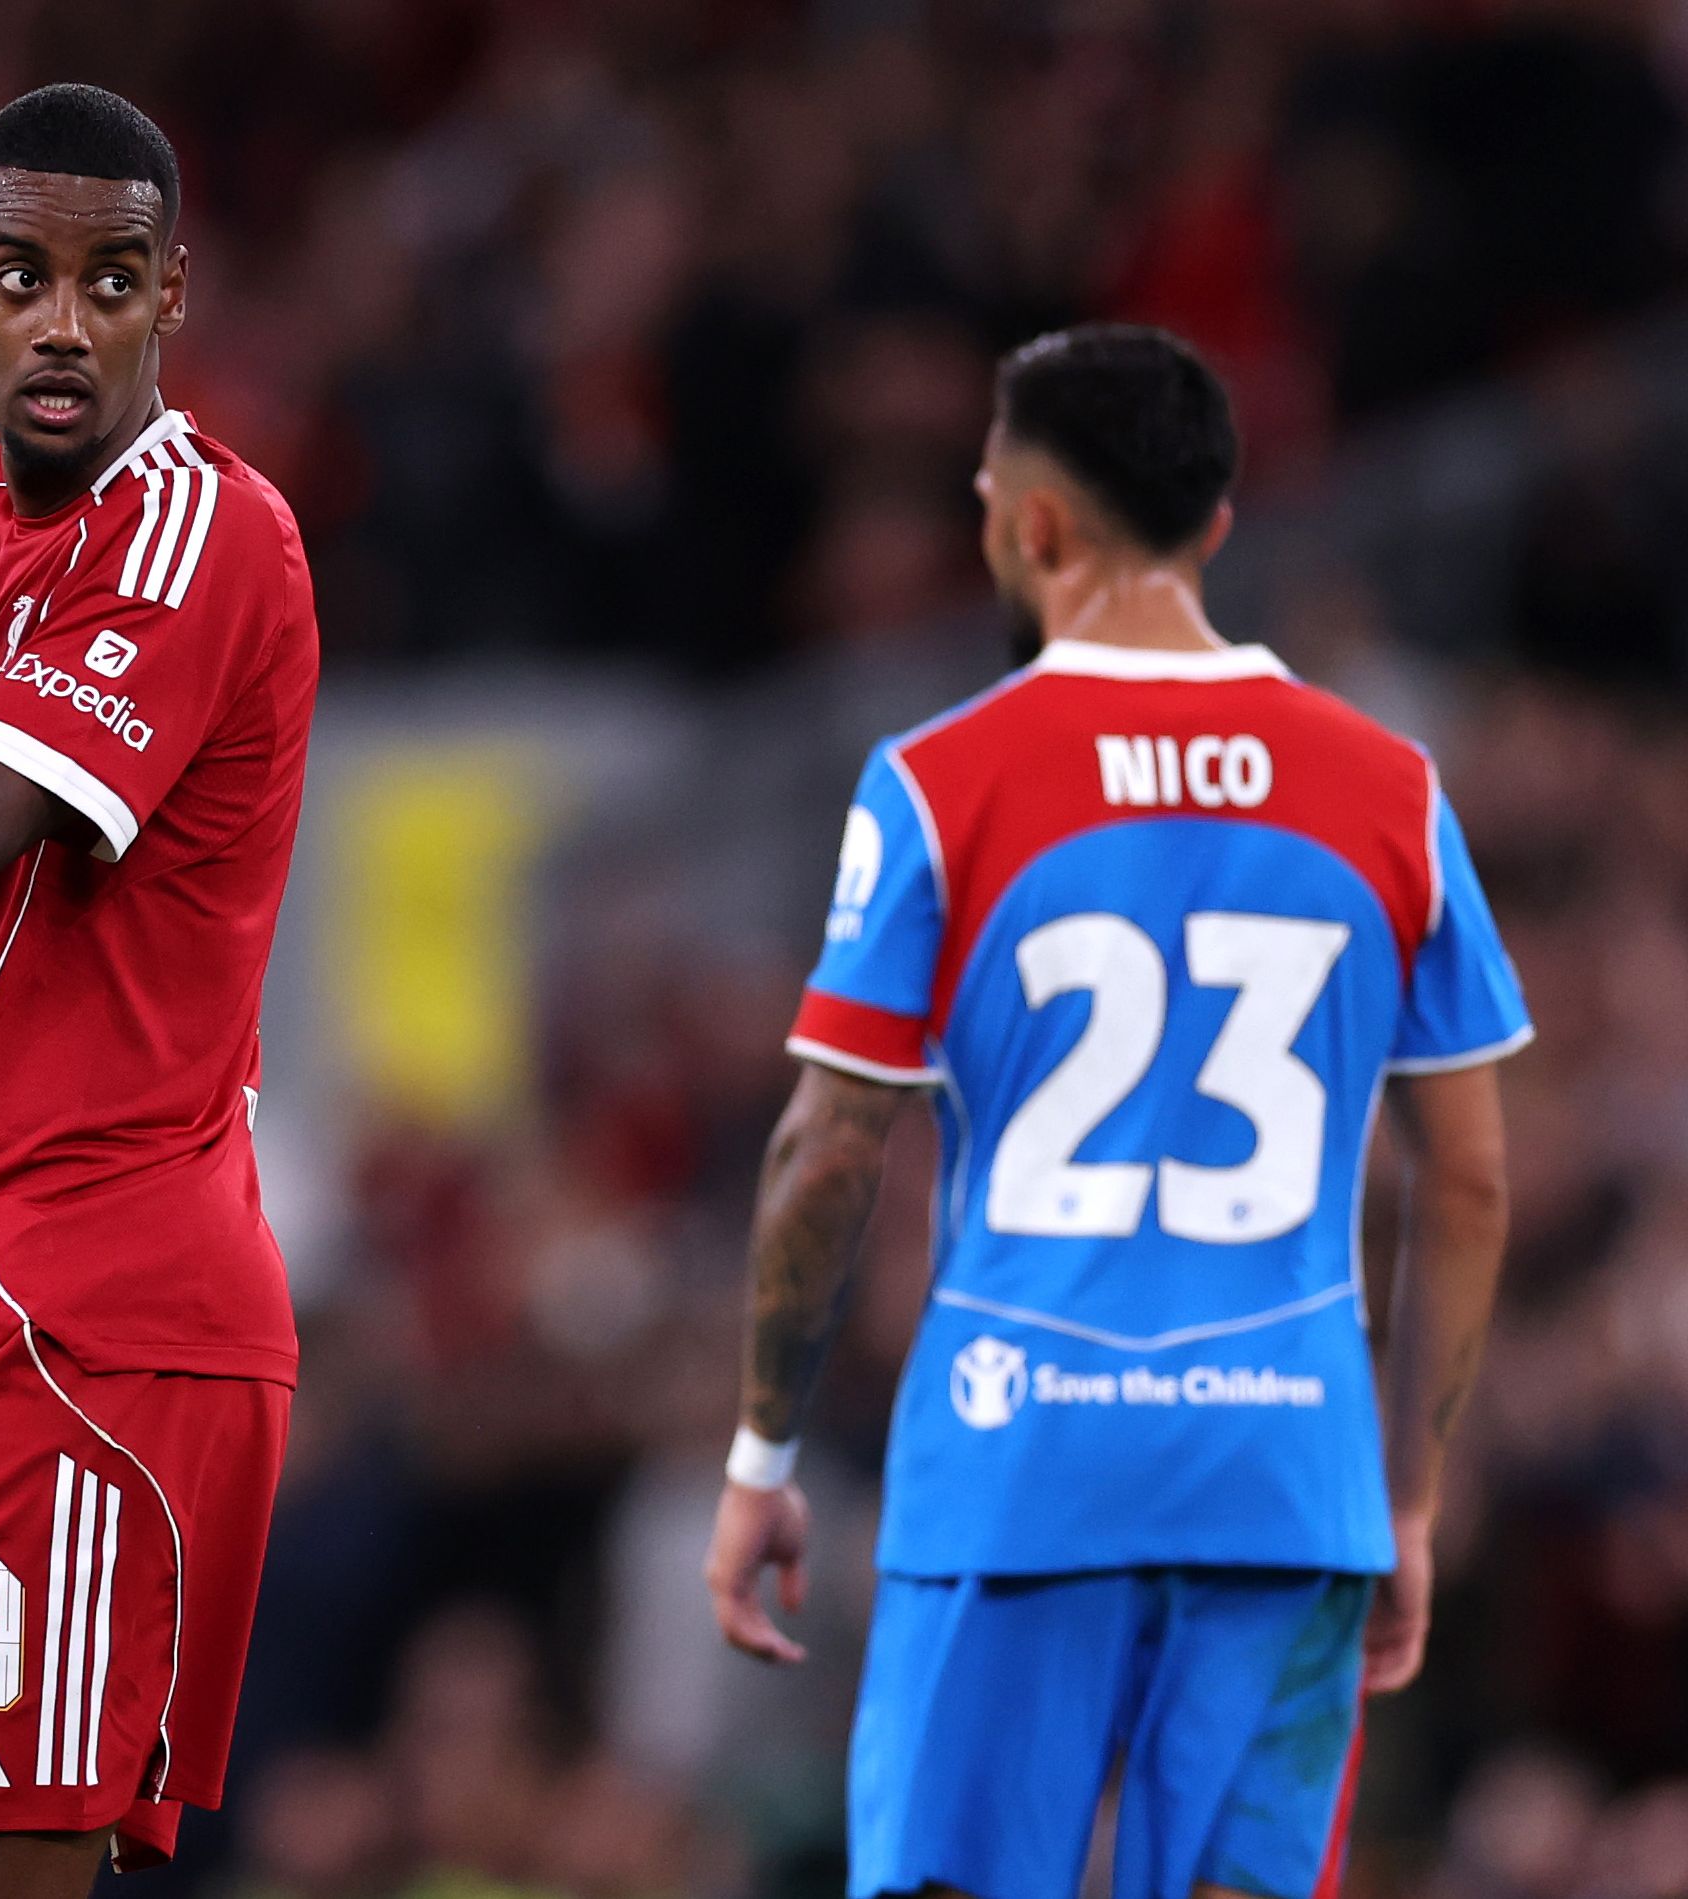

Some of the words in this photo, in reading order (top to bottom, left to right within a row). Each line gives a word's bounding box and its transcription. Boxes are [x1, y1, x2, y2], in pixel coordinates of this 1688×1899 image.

[5, 653, 154, 752] Expedia
[1096, 734, 1273, 808] NICO
[985, 910, 1351, 1245] 23
[1032, 1362, 1113, 1405] Save
[1120, 1366, 1179, 1406] the
[1182, 1365, 1325, 1408] Children
